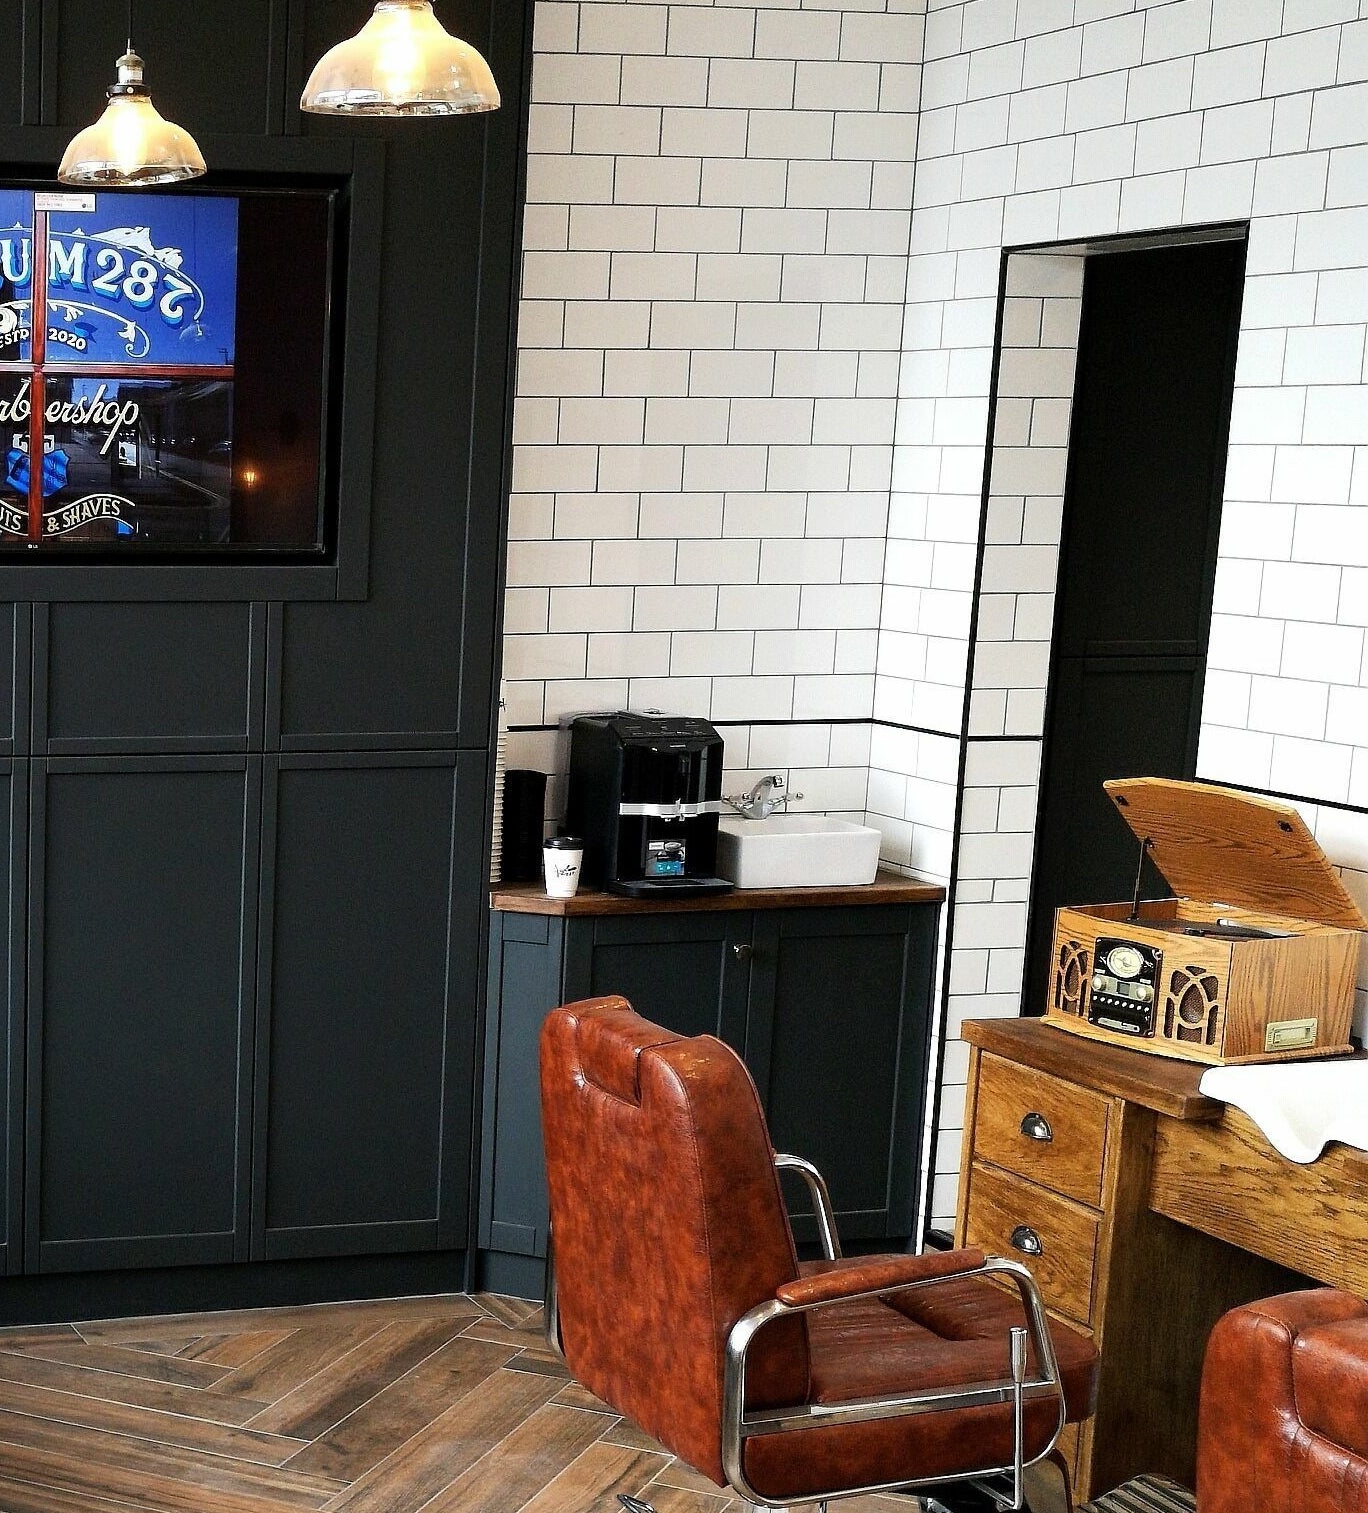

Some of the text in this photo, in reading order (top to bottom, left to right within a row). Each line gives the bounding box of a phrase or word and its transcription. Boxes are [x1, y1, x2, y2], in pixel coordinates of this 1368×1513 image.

[93, 249, 194, 327] 287
[48, 328, 86, 350] 2020
[47, 517, 60, 532] &
[62, 499, 121, 528] SHAVES
